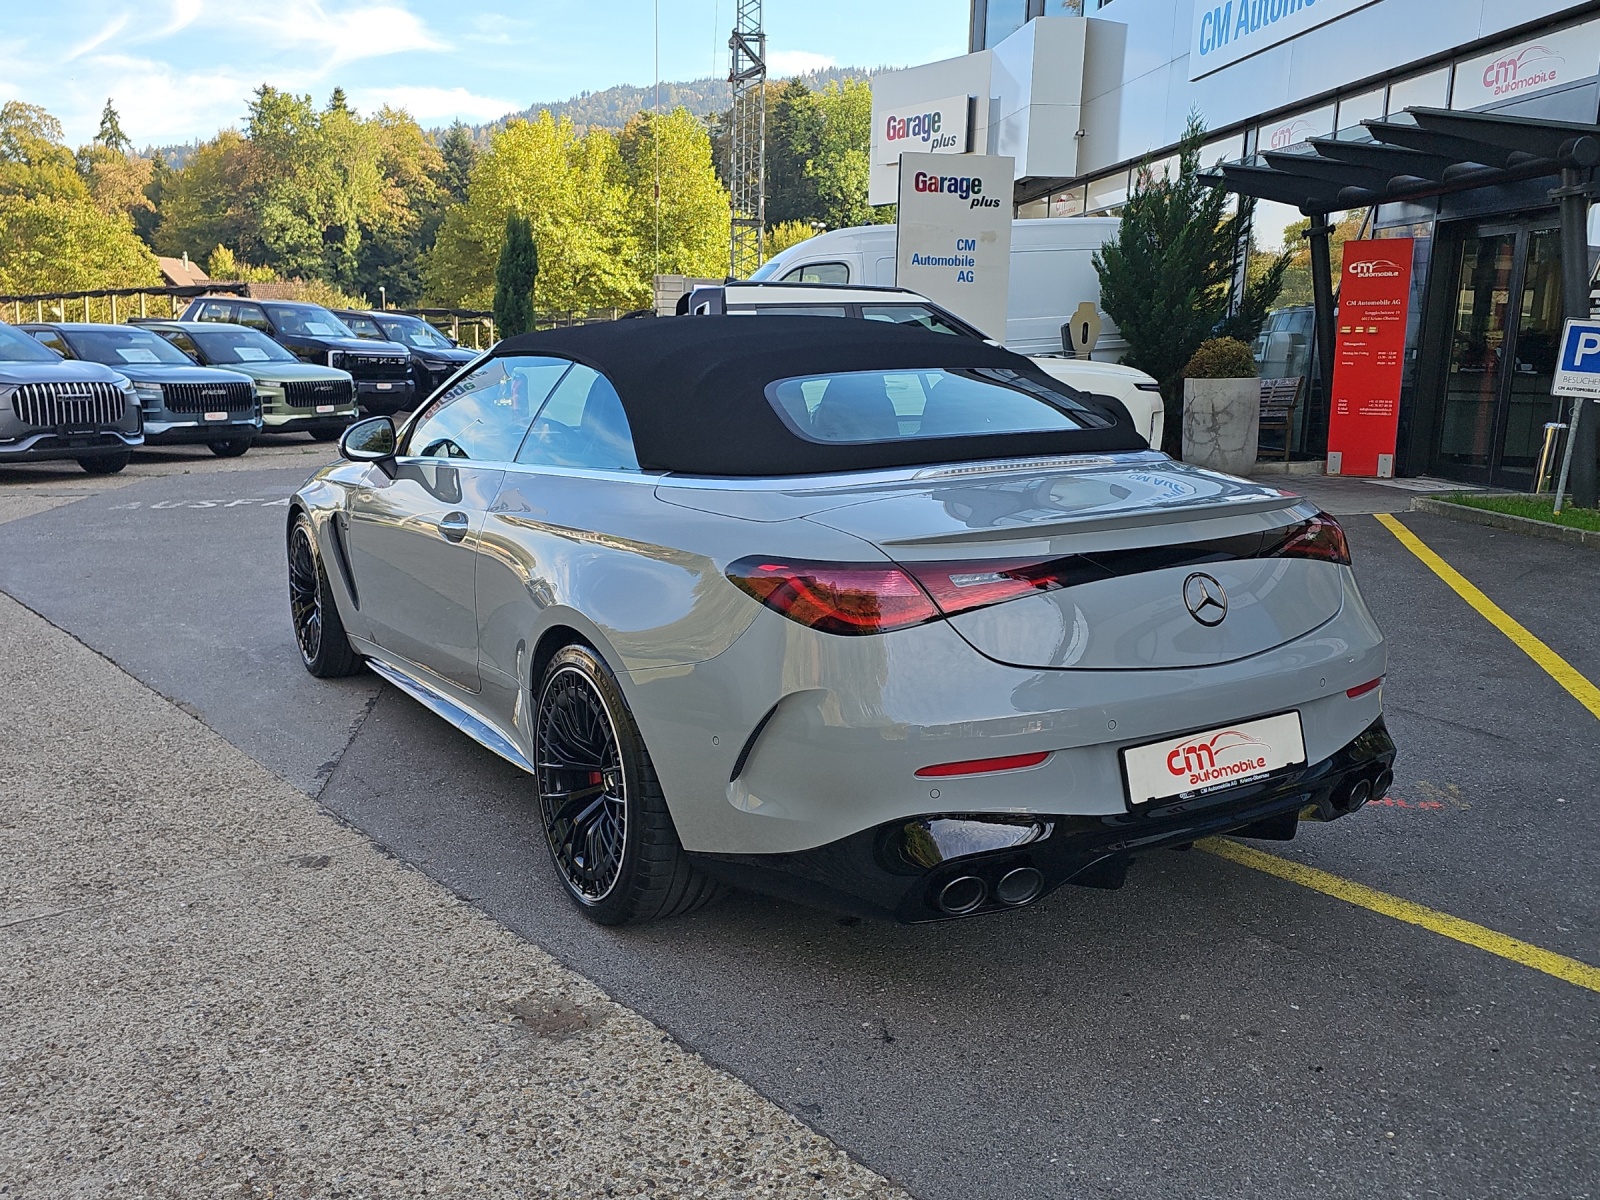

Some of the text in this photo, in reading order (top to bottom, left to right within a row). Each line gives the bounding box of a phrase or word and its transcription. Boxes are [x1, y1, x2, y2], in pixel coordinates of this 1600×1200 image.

[1200, 0, 1316, 55] CM Auto
[1483, 58, 1518, 87] cm
[1494, 70, 1557, 95] automobile
[887, 112, 941, 142] Garage
[931, 133, 957, 152] plus
[914, 172, 982, 200] Garage
[970, 196, 1001, 209] plus
[957, 239, 976, 251] CM
[911, 253, 975, 267] Automobile
[1349, 263, 1373, 273] cm
[957, 270, 974, 283] AG
[1574, 332, 1600, 366] P
[1167, 743, 1215, 776] cm
[1190, 756, 1267, 785] automobile
[1208, 783, 1230, 792] Automobile
